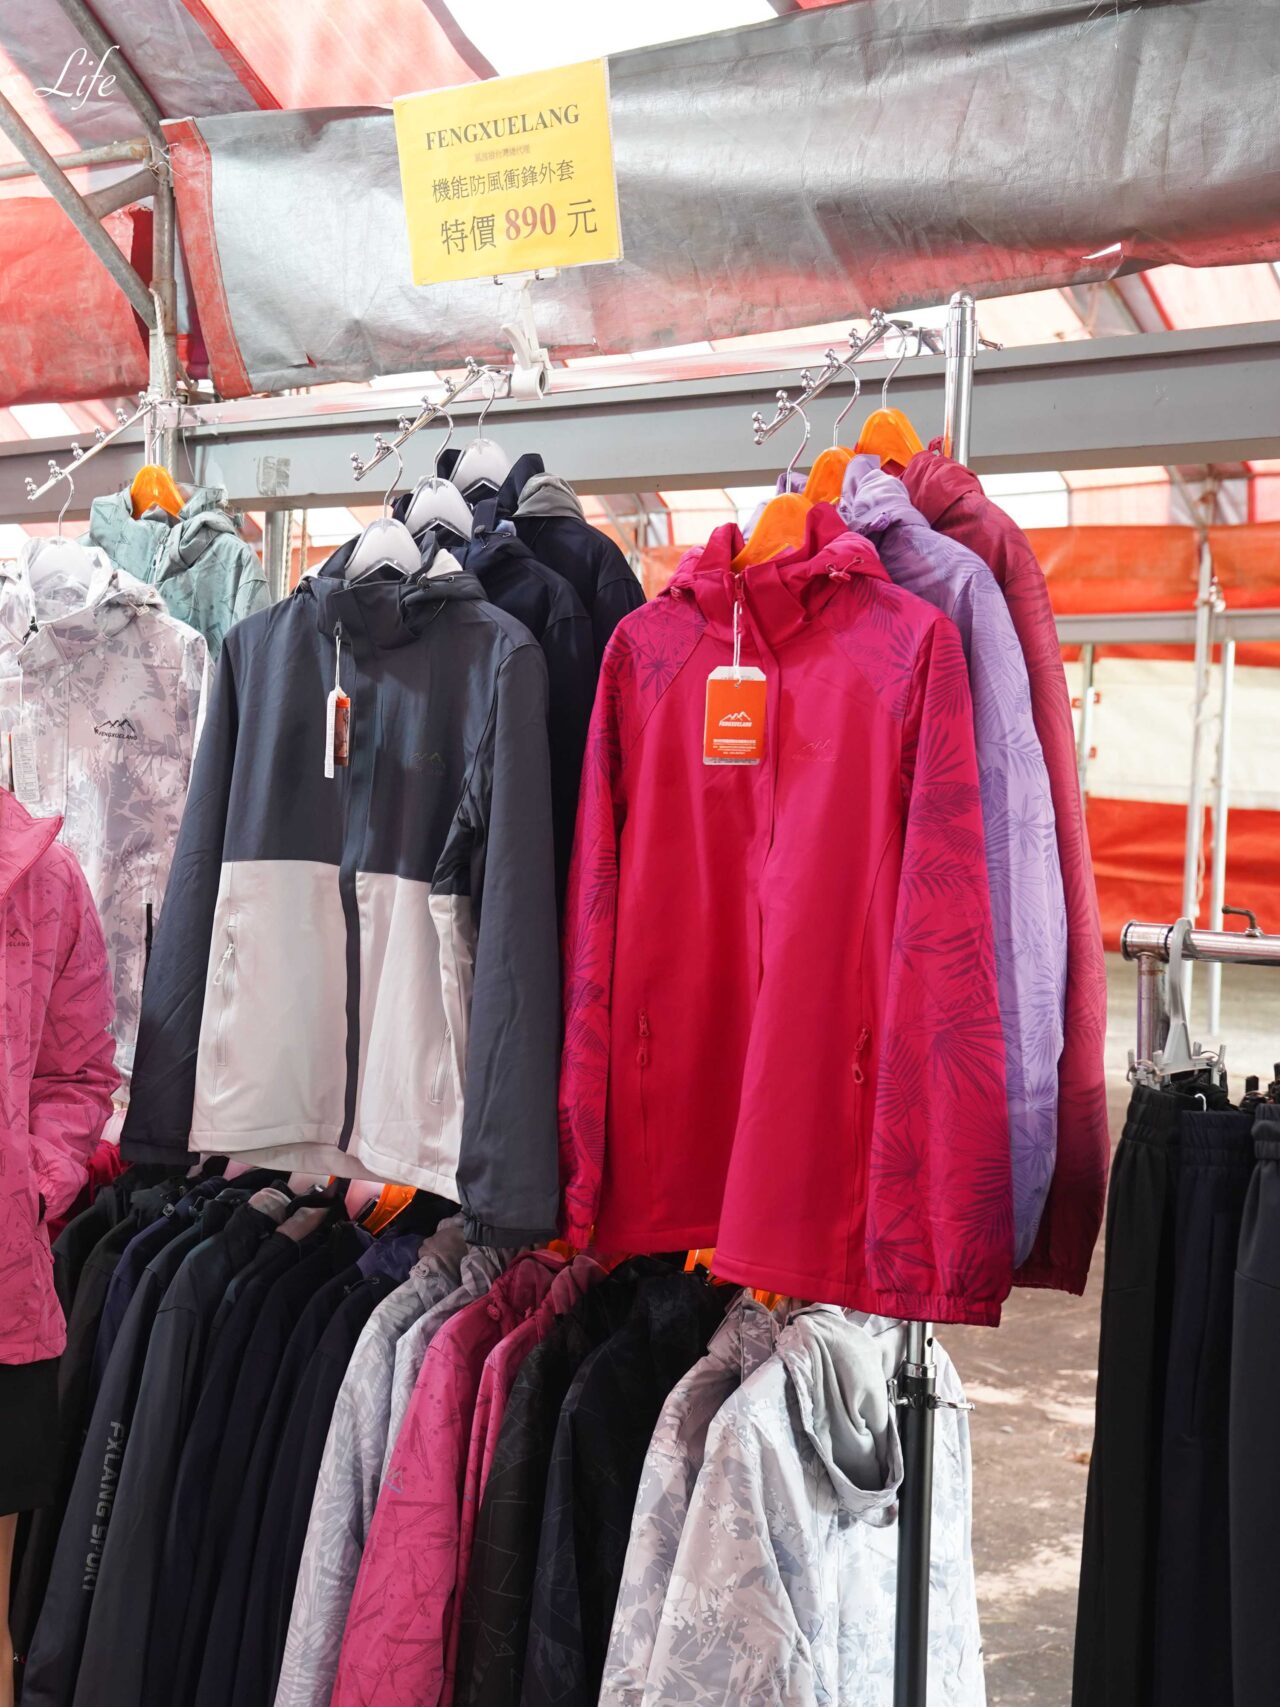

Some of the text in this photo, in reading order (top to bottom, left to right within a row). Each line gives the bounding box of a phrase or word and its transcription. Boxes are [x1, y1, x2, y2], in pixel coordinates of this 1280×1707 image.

[425, 104, 580, 150] FENGXUELANG
[432, 159, 575, 203] 機能防風衝鋒外套
[440, 198, 598, 255] 特價 890 元
[96, 1420, 125, 1517] FXLANG
